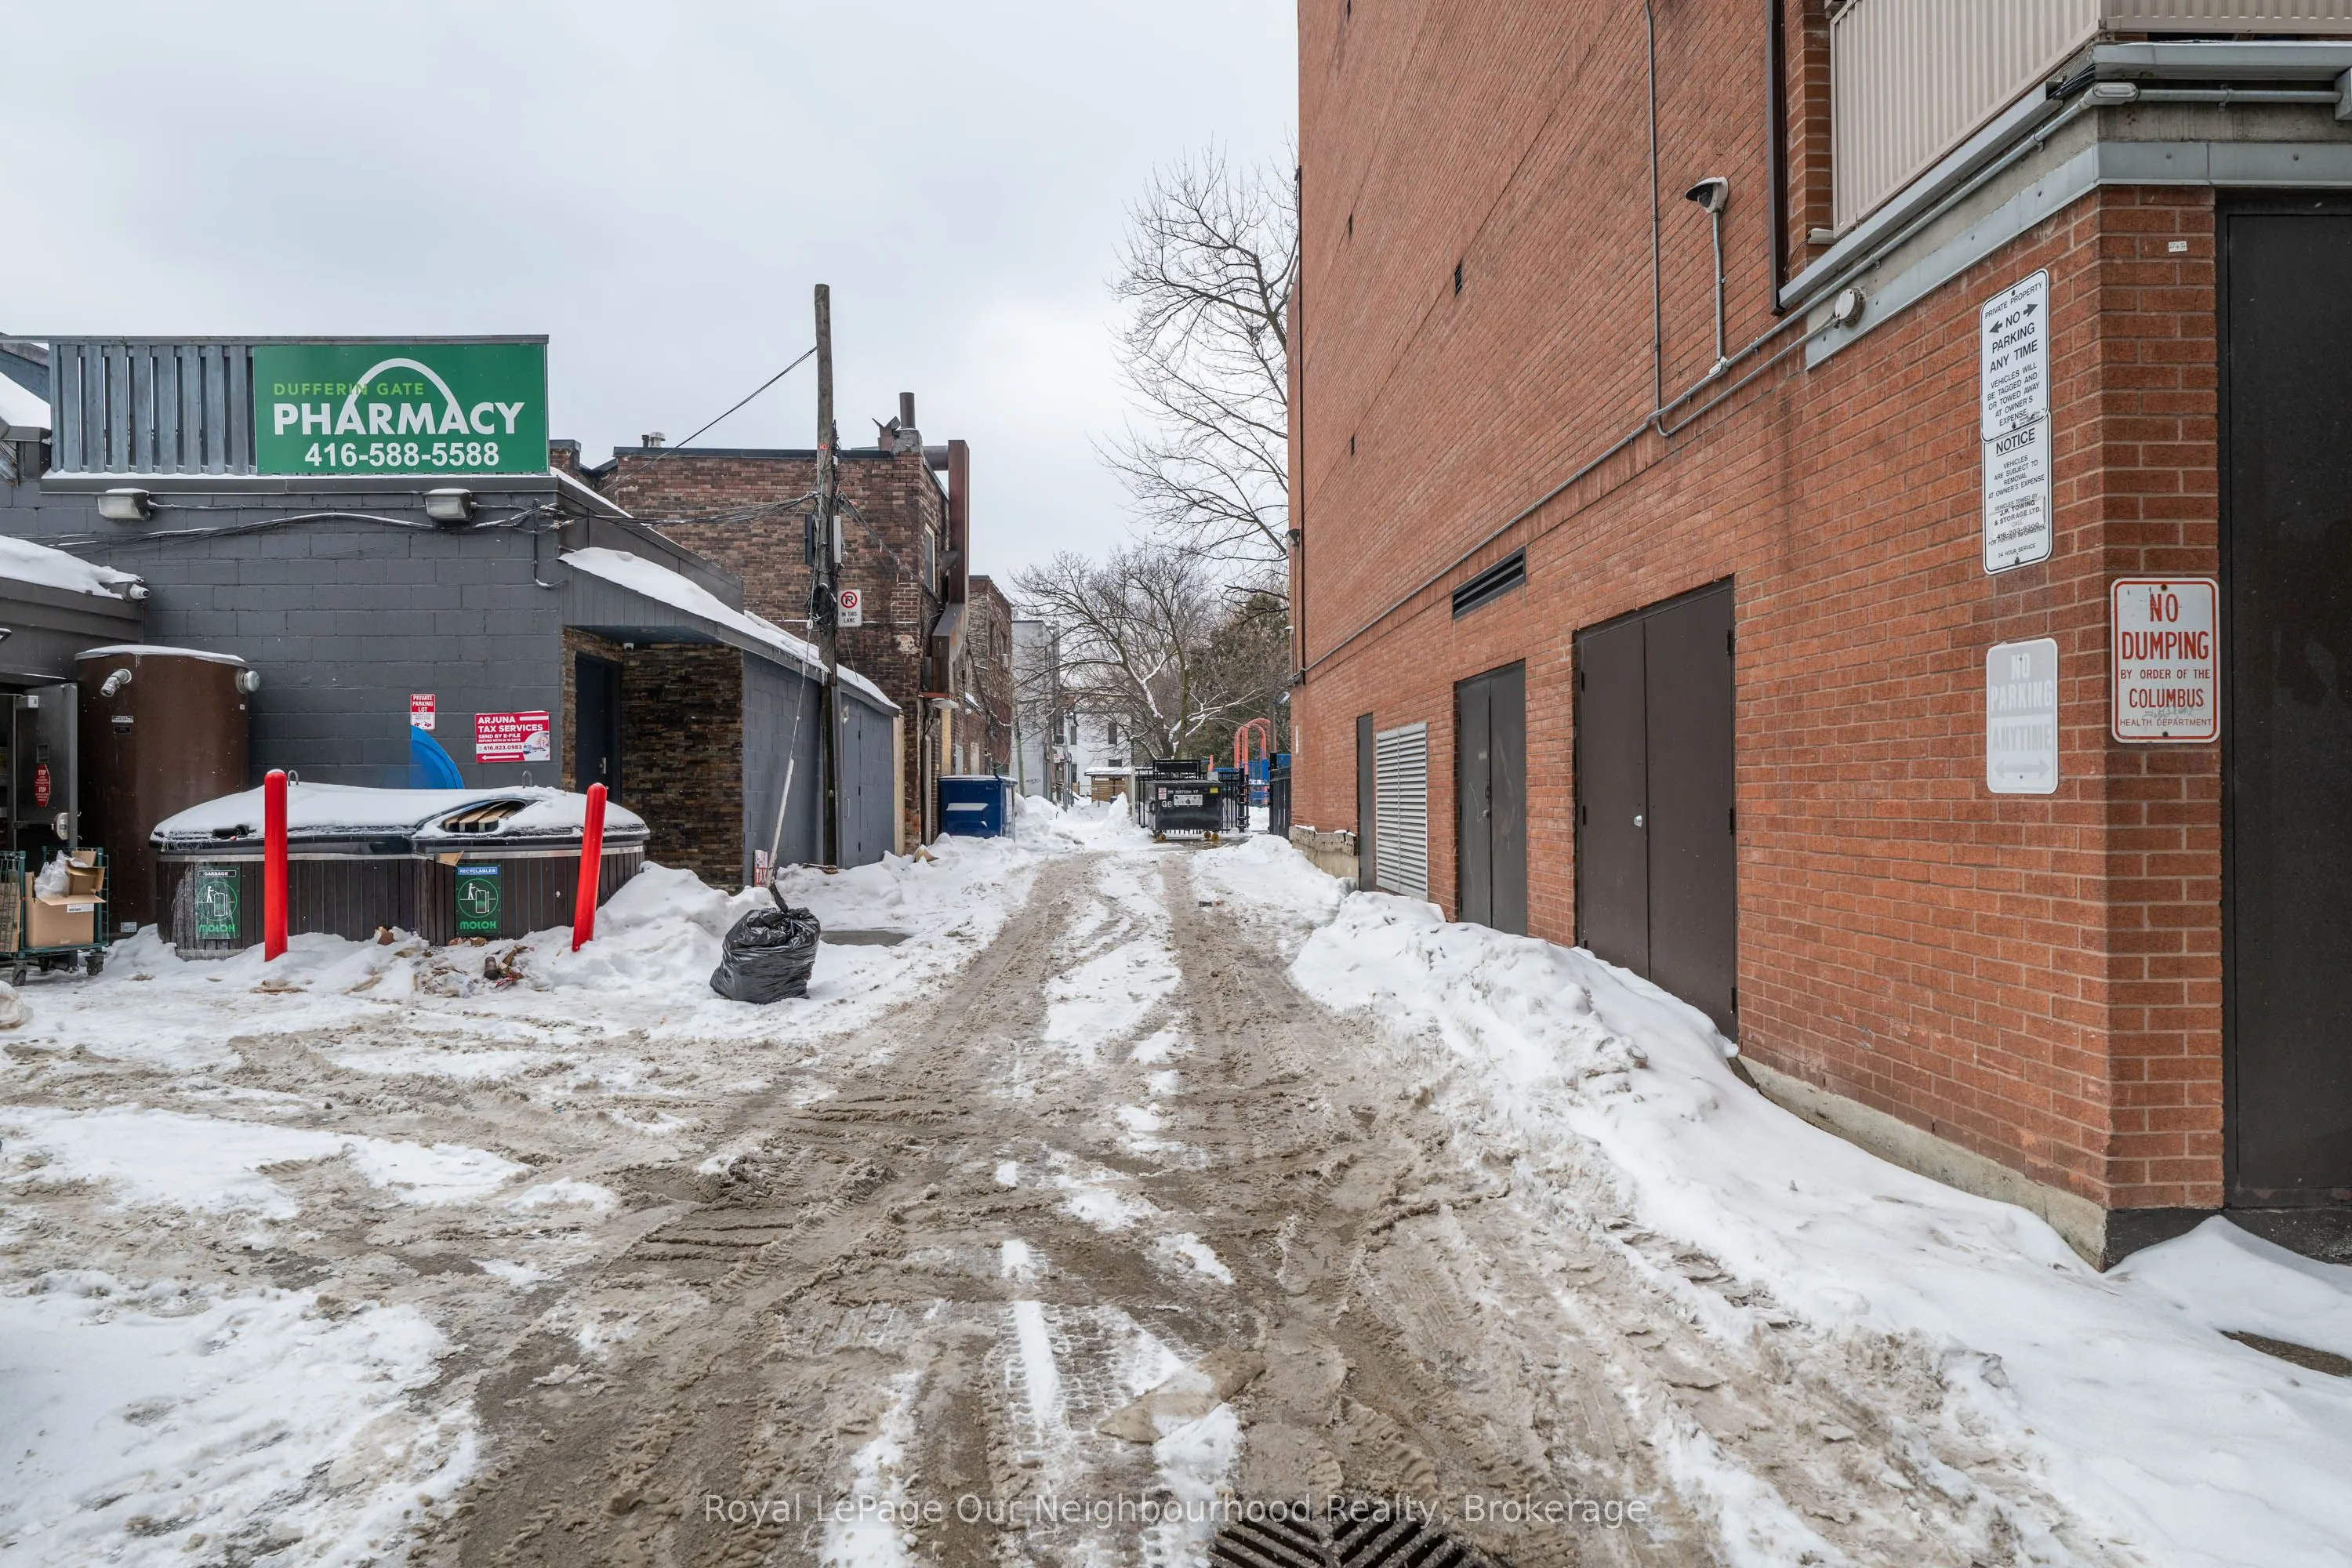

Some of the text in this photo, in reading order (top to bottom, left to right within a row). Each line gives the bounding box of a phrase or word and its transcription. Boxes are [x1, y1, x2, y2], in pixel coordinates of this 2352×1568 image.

[1985, 281, 2043, 319] PRIVATE PROPERTY
[2005, 311, 2020, 328] NO
[1992, 322, 2035, 354] PARKING
[1990, 339, 2038, 373] ANY TIME
[1987, 372, 2038, 401] BE TAGGED AND
[1991, 361, 2037, 389] VEHICLES WILL
[274, 383, 424, 396] DUFFERIN GATE
[1988, 381, 2040, 410] OR TOWED AWAY
[274, 401, 525, 435] PHARMACY
[1995, 395, 2033, 418] AT OWNER'S
[1996, 427, 2035, 455] NOTICE
[304, 441, 499, 466] 416-588-5588
[2003, 455, 2028, 469] VEHICLES
[1994, 472, 2004, 481] ARE
[2006, 463, 2029, 476] SUBJECT
[2004, 472, 2027, 485] REMOVAL
[1996, 483, 2019, 497] OWNER'S
[2021, 474, 2045, 488] EXPENSE
[1994, 500, 2014, 511] VEHICLES
[2000, 510, 2027, 524] STORAGE
[2011, 499, 2035, 512] TOWING
[2018, 543, 2036, 553] SERVICE
[2150, 593, 2179, 622] NO
[2122, 631, 2209, 660] DUMPING
[2010, 652, 2031, 680] NO
[2121, 670, 2211, 679] BY ORDER OF THE
[1991, 681, 2053, 711] PARKING
[2129, 688, 2204, 708] COLUMBUS
[499, 724, 543, 732] SERVICES
[2120, 718, 2212, 727] HEALTH DEPARTMENT
[1992, 723, 2052, 752] ANYTIME
[756, 868, 767, 884] TAX
